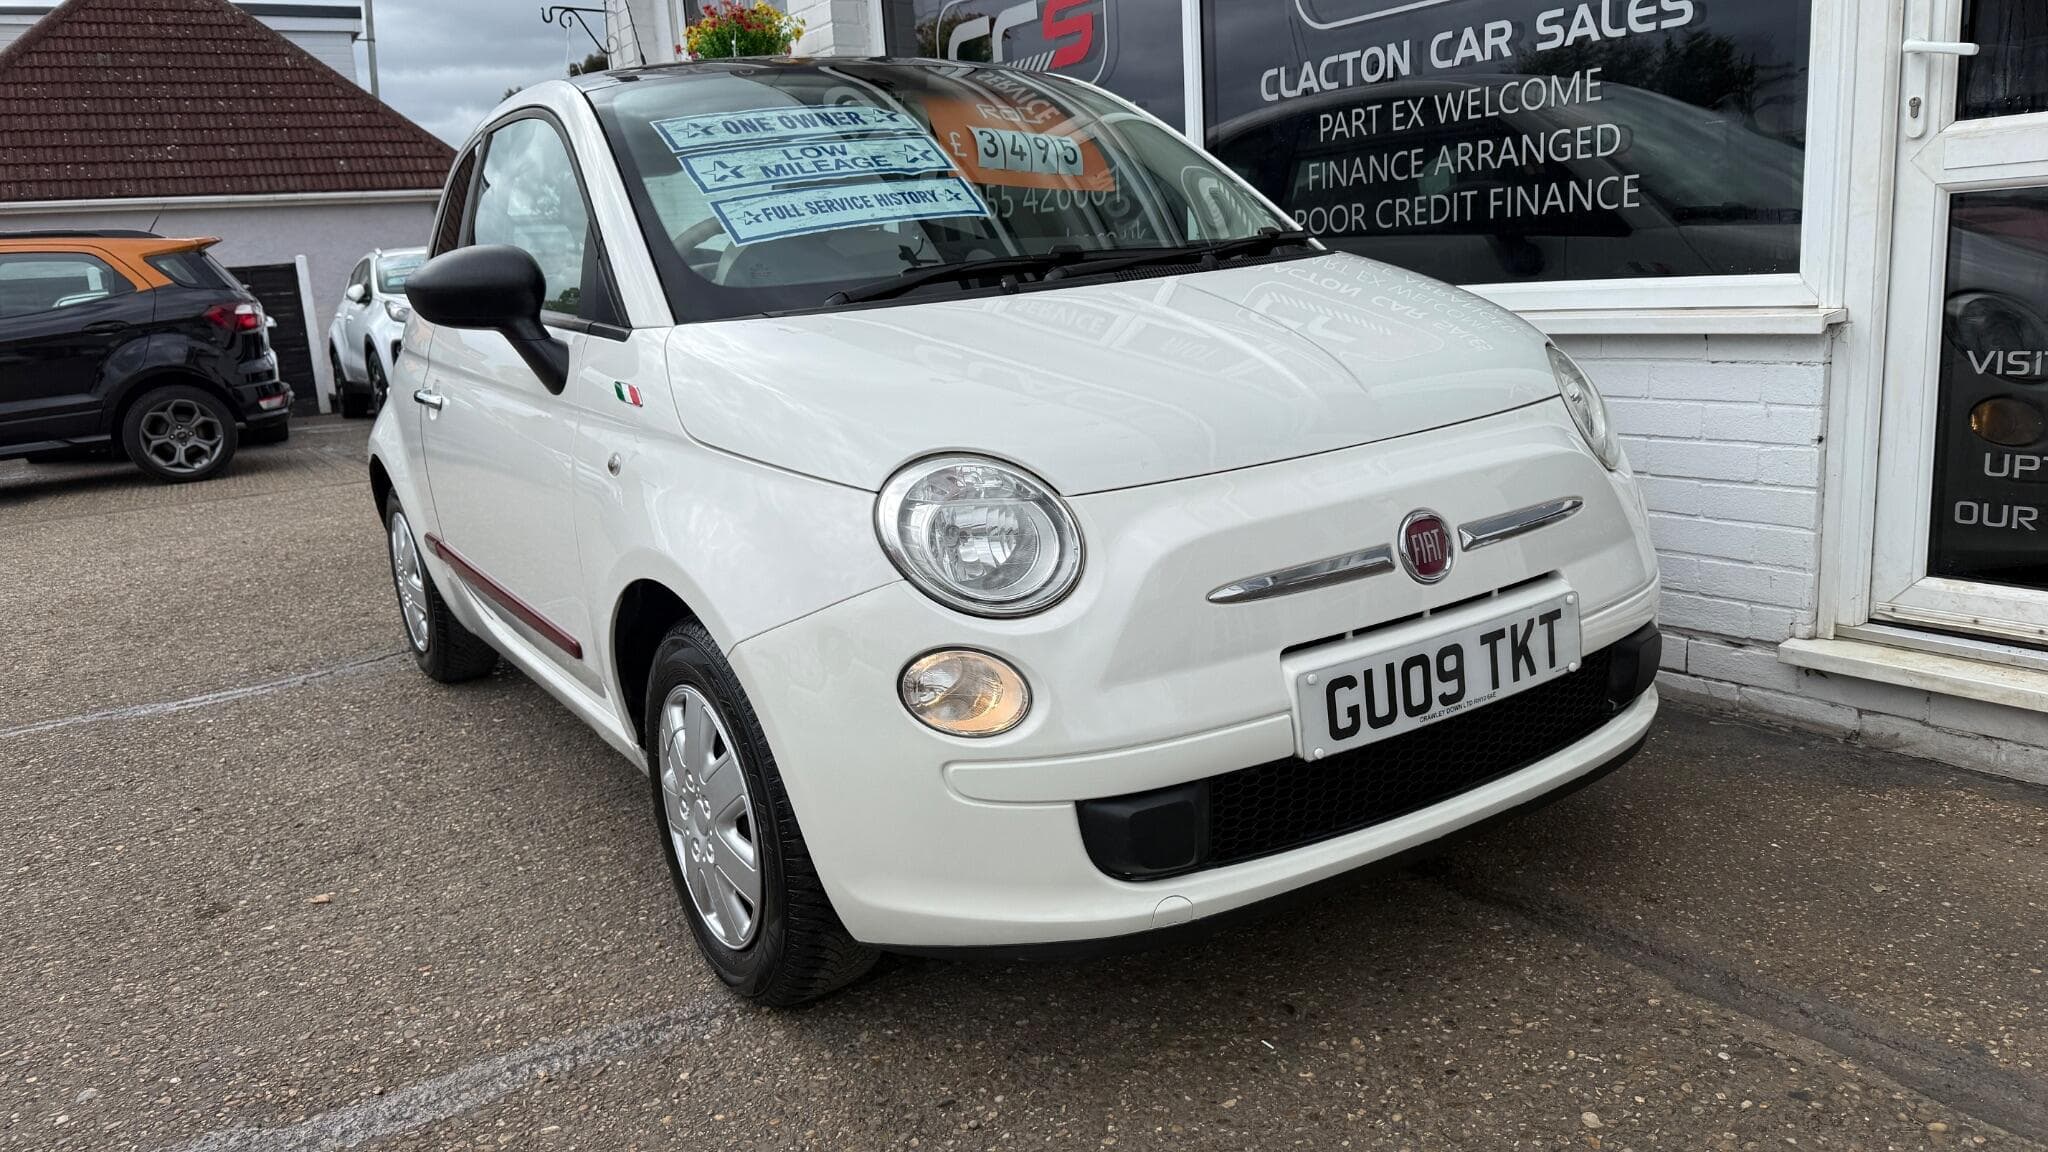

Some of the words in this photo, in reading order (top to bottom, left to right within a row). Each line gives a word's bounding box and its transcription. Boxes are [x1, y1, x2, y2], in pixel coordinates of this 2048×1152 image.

[1260, 40, 1411, 101] CLACTON
[1430, 20, 1513, 68] CAR
[1535, 0, 1694, 52] SALES
[1319, 105, 1382, 142] PART
[1392, 97, 1425, 131] EX
[1434, 67, 1602, 124] WELCOME
[722, 117, 775, 136] ONE
[777, 111, 868, 130] OWNER
[781, 143, 848, 161] LOW
[949, 132, 967, 157] £
[979, 130, 1078, 165] 3495
[1308, 147, 1425, 191] FINANCE
[1433, 123, 1621, 176] ARRANGED
[759, 154, 893, 178] MILEAGE
[762, 205, 807, 222] FULL
[806, 195, 875, 215] SERVICE
[878, 188, 939, 208] HISTORY
[1294, 203, 1367, 235] POOR
[1376, 190, 1477, 229] CREDIT
[1490, 174, 1640, 220] FINANCE
[1984, 452, 2048, 478] UP
[1954, 501, 2038, 531] OUR
[1410, 527, 1441, 567] FIAT
[1325, 643, 1466, 742] GU09
[1480, 608, 1562, 691] TKT
